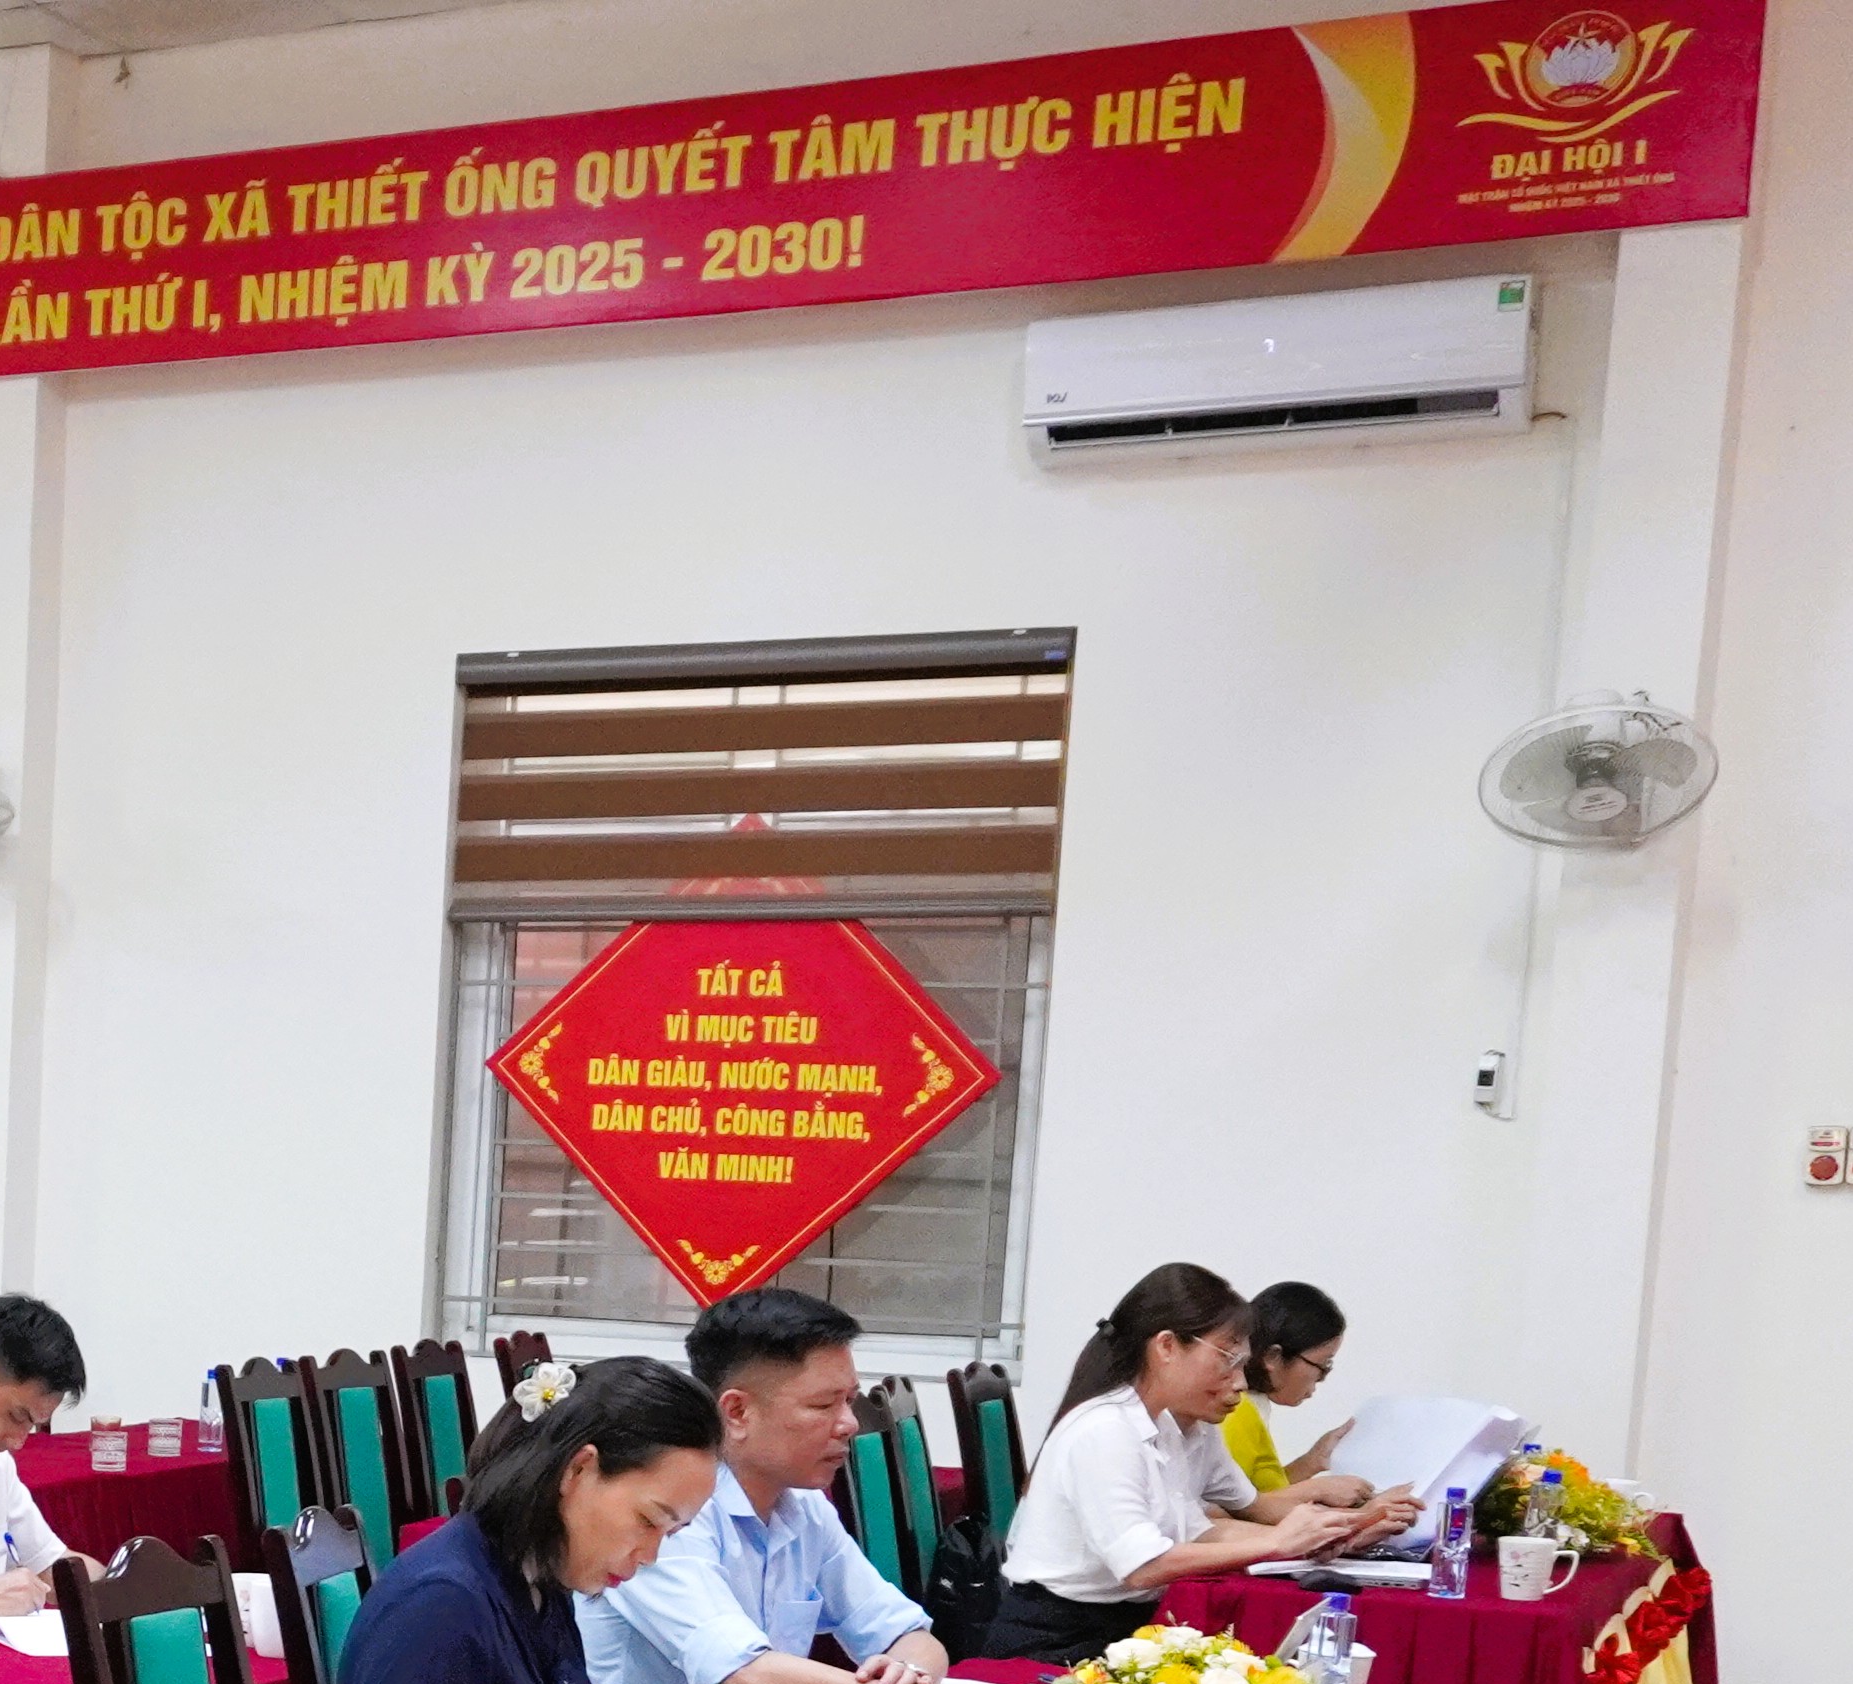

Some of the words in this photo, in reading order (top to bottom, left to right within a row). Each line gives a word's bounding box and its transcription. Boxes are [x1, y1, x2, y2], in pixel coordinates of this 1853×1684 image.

[97, 191, 187, 259] TỘC
[203, 179, 270, 242] XÃ
[288, 157, 430, 234] THIẾT
[445, 147, 557, 217] ỐNG
[575, 121, 752, 209] QUYẾT
[769, 114, 895, 183] TÂM
[915, 96, 1072, 171] THỰC
[1092, 72, 1246, 153] HIỆN
[1490, 149, 1552, 181] ĐẠI
[1562, 139, 1624, 174] HỘI
[1635, 139, 1648, 165] I
[85, 273, 184, 337] THỨ
[192, 279, 221, 333] I,
[238, 255, 409, 327] NHIỆM
[426, 242, 496, 305] KỲ
[509, 238, 644, 298] 2025
[661, 256, 684, 270] -
[701, 214, 866, 282] 2030!
[697, 959, 742, 996] TẤT
[749, 960, 783, 997] CẢ
[665, 1008, 690, 1042] VÌ
[696, 1014, 754, 1048] MỤC
[761, 1010, 817, 1044] TIÊU
[587, 1053, 640, 1085] DÂN
[646, 1054, 712, 1091] GIÀU,
[719, 1057, 790, 1090] NƯỚC
[797, 1063, 883, 1098] MẠNH,
[592, 1098, 643, 1131] DÂN
[650, 1097, 707, 1137] CHỦ,
[715, 1102, 785, 1136] CÔNG
[792, 1100, 871, 1143] BẰNG,
[658, 1146, 709, 1180] VĂN
[715, 1153, 795, 1184] MINH!
